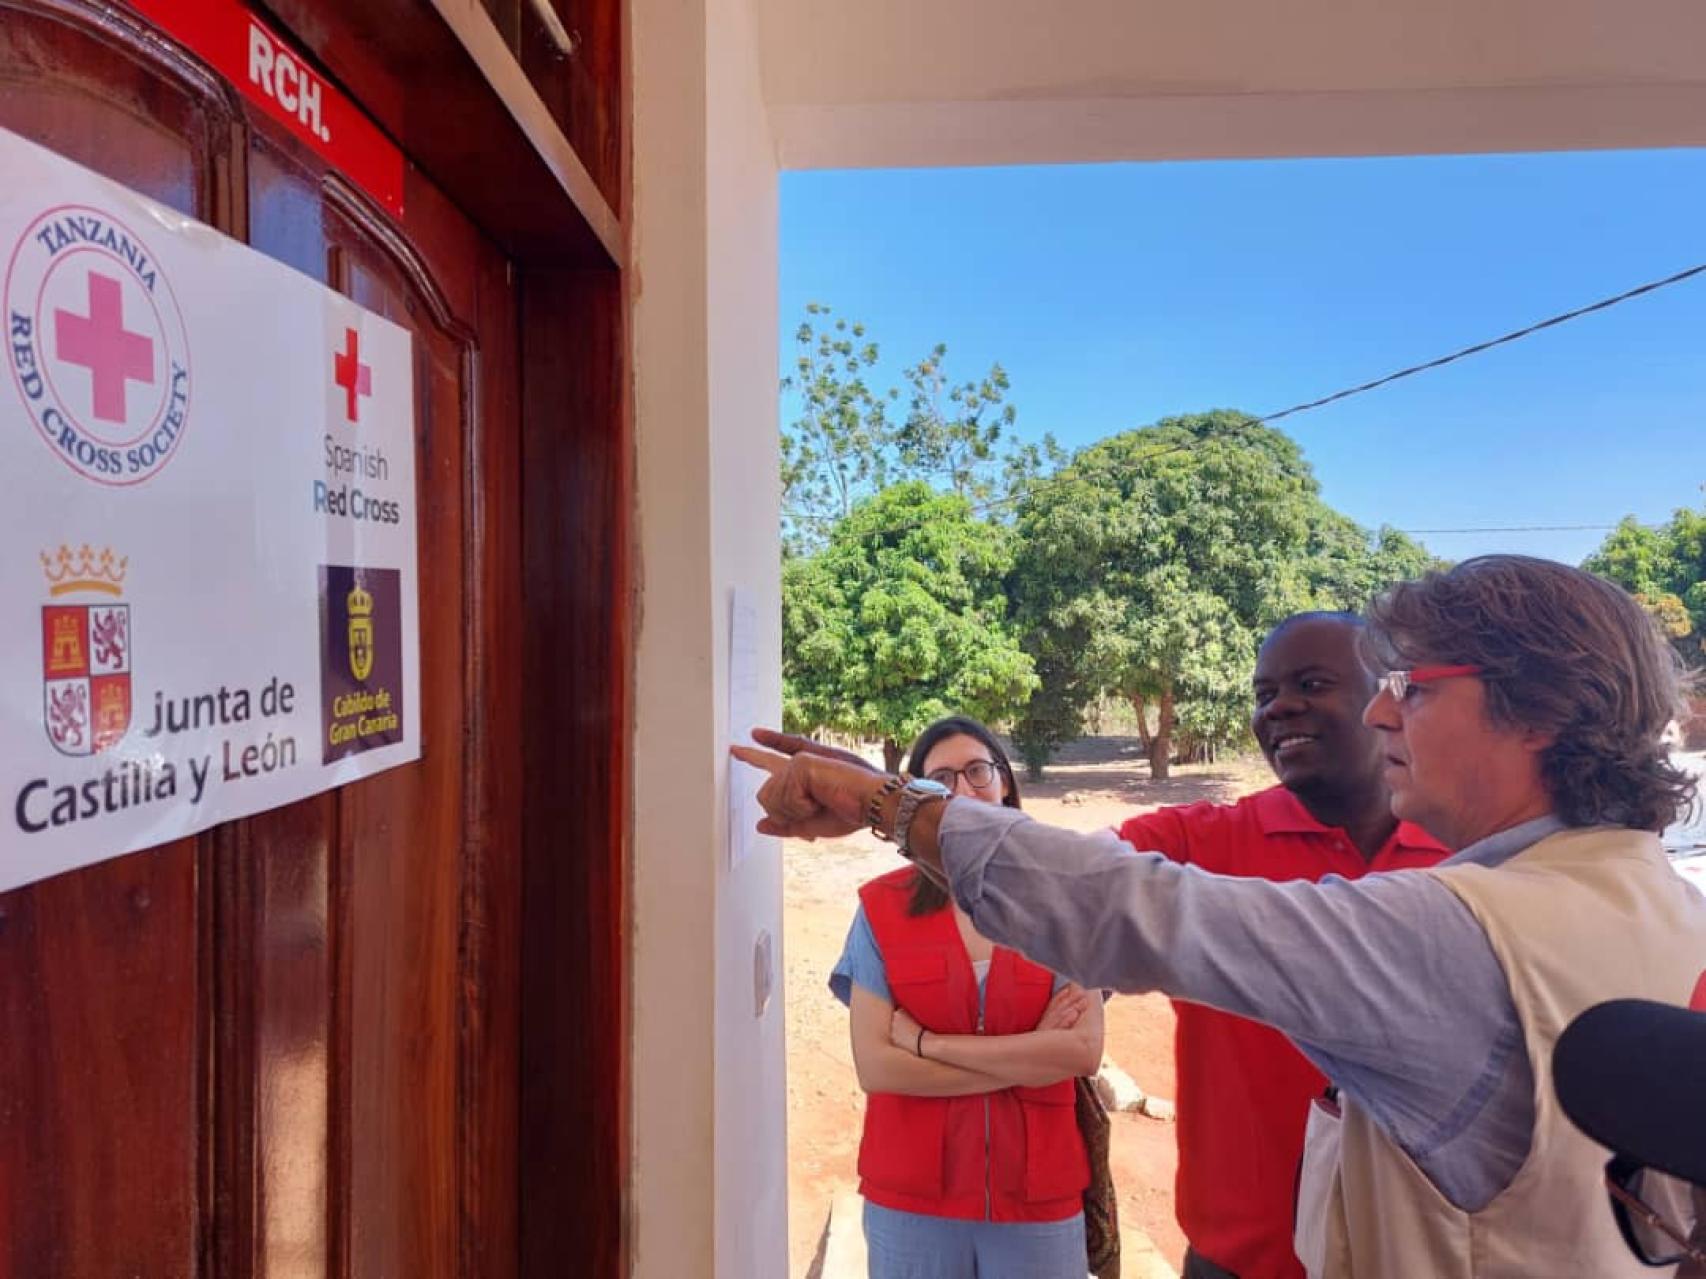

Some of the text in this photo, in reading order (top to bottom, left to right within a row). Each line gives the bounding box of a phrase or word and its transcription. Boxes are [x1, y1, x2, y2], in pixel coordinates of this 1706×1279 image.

[249, 23, 330, 143] RCH.
[37, 215, 157, 291] TANZANIA
[11, 309, 187, 474] RED CROSS SOCIETY
[324, 433, 389, 480] Spanish
[313, 479, 400, 525] Red Cross
[260, 675, 295, 718] de
[375, 688, 391, 708] de
[330, 711, 398, 745] Gran Canaria
[15, 732, 297, 833] Castilla y León
